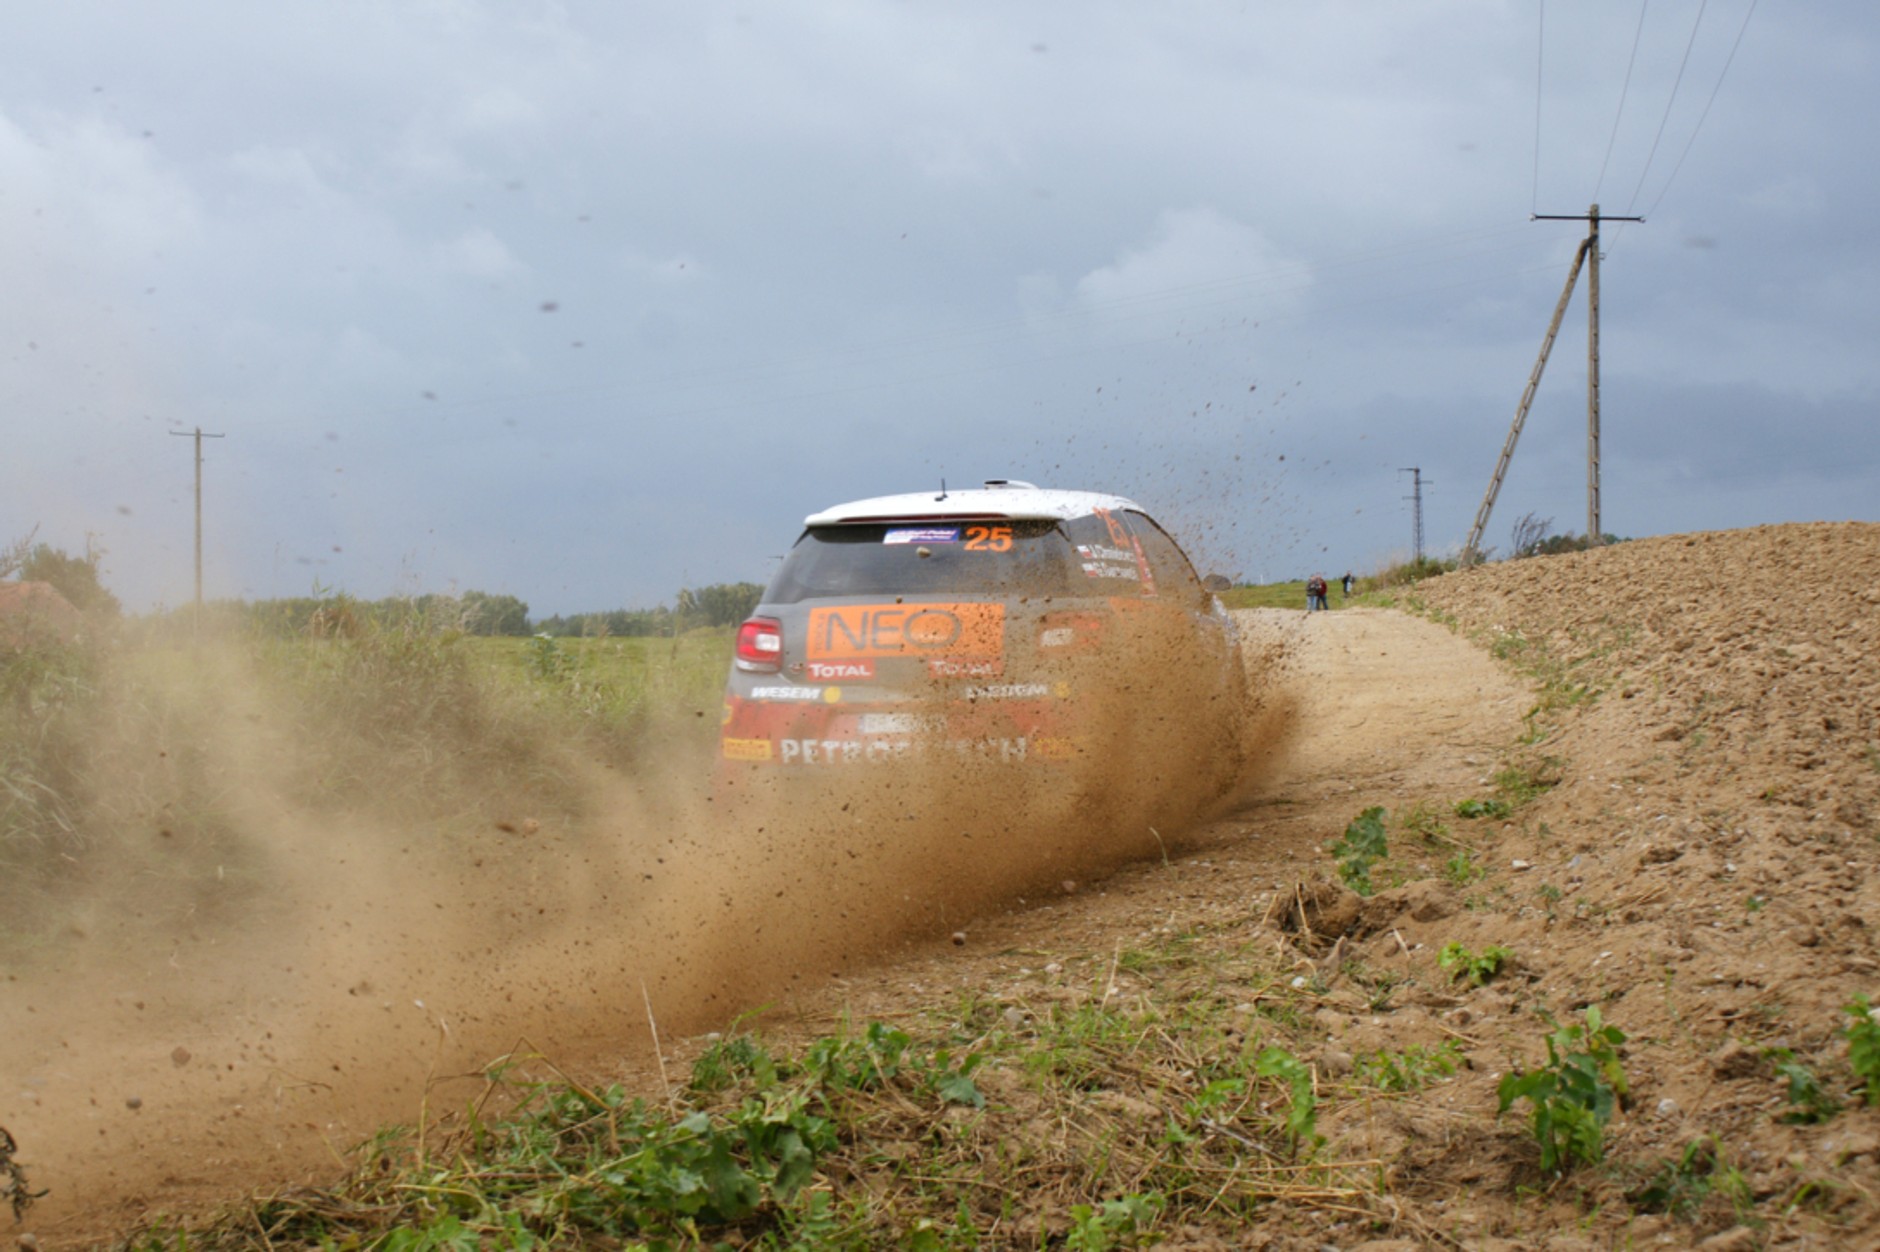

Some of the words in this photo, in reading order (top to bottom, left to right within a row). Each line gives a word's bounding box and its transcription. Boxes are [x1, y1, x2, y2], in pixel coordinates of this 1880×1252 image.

[963, 526, 1013, 552] 25
[826, 608, 962, 652] NEO
[809, 663, 873, 678] TOTAL
[751, 686, 821, 699] WESEM
